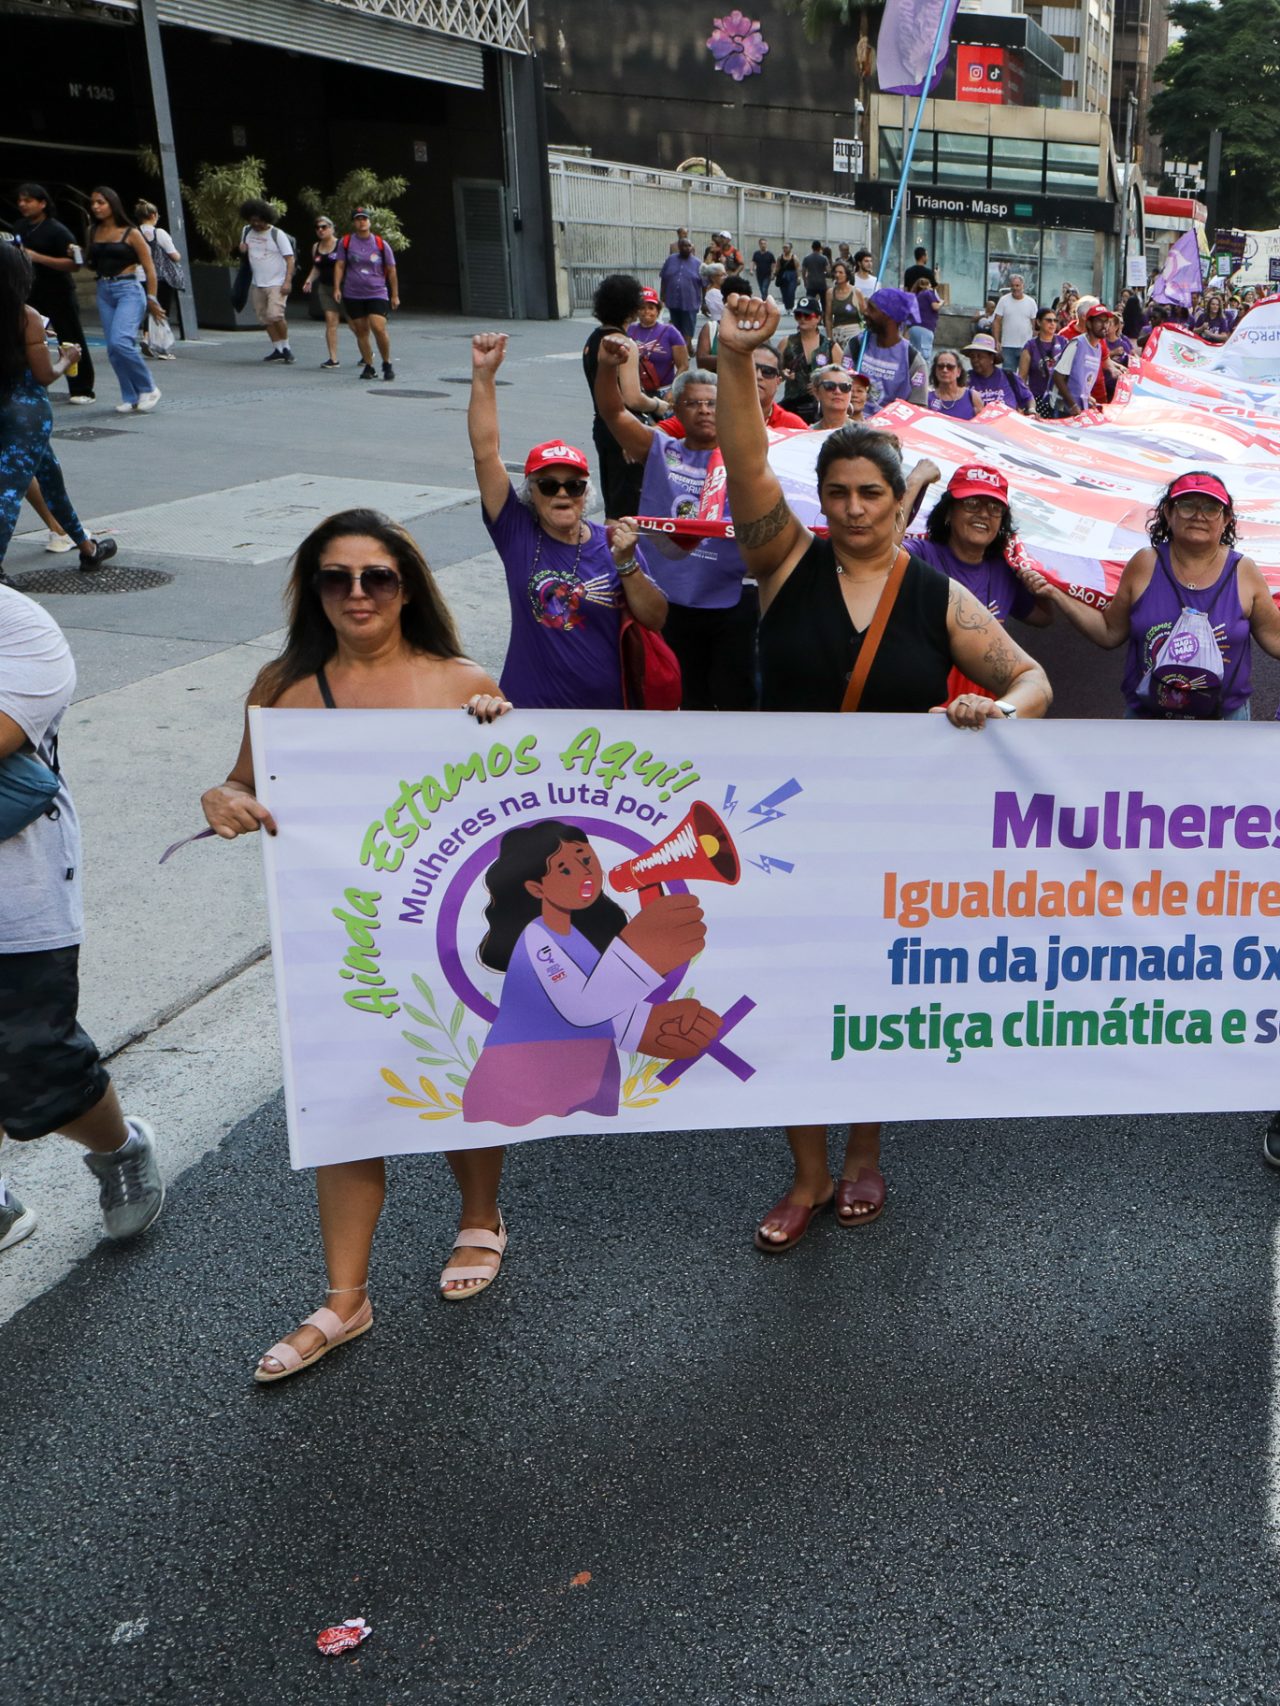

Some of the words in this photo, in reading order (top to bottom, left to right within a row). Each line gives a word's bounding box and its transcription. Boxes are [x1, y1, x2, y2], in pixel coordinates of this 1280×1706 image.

[86, 85, 115, 101] 1343
[915, 195, 964, 212] Trianon
[971, 200, 1008, 217] Masp
[541, 446, 581, 463] CUT
[967, 469, 1000, 487] CUT
[1068, 583, 1095, 604] SÃO
[560, 726, 700, 805] Aqui!
[360, 734, 542, 873] Estamos
[399, 806, 498, 924] Mulheres
[499, 788, 542, 817] na
[548, 783, 609, 806] luta
[615, 798, 668, 829] por
[883, 869, 1123, 928] Igualdade
[1132, 869, 1188, 917] de
[332, 887, 400, 1018] Ainda
[888, 937, 968, 985] fim
[978, 935, 1038, 983] da
[1045, 934, 1223, 991] jornada
[831, 1003, 994, 1064] justiça
[1002, 997, 1212, 1048] climática
[1221, 1008, 1247, 1044] e
